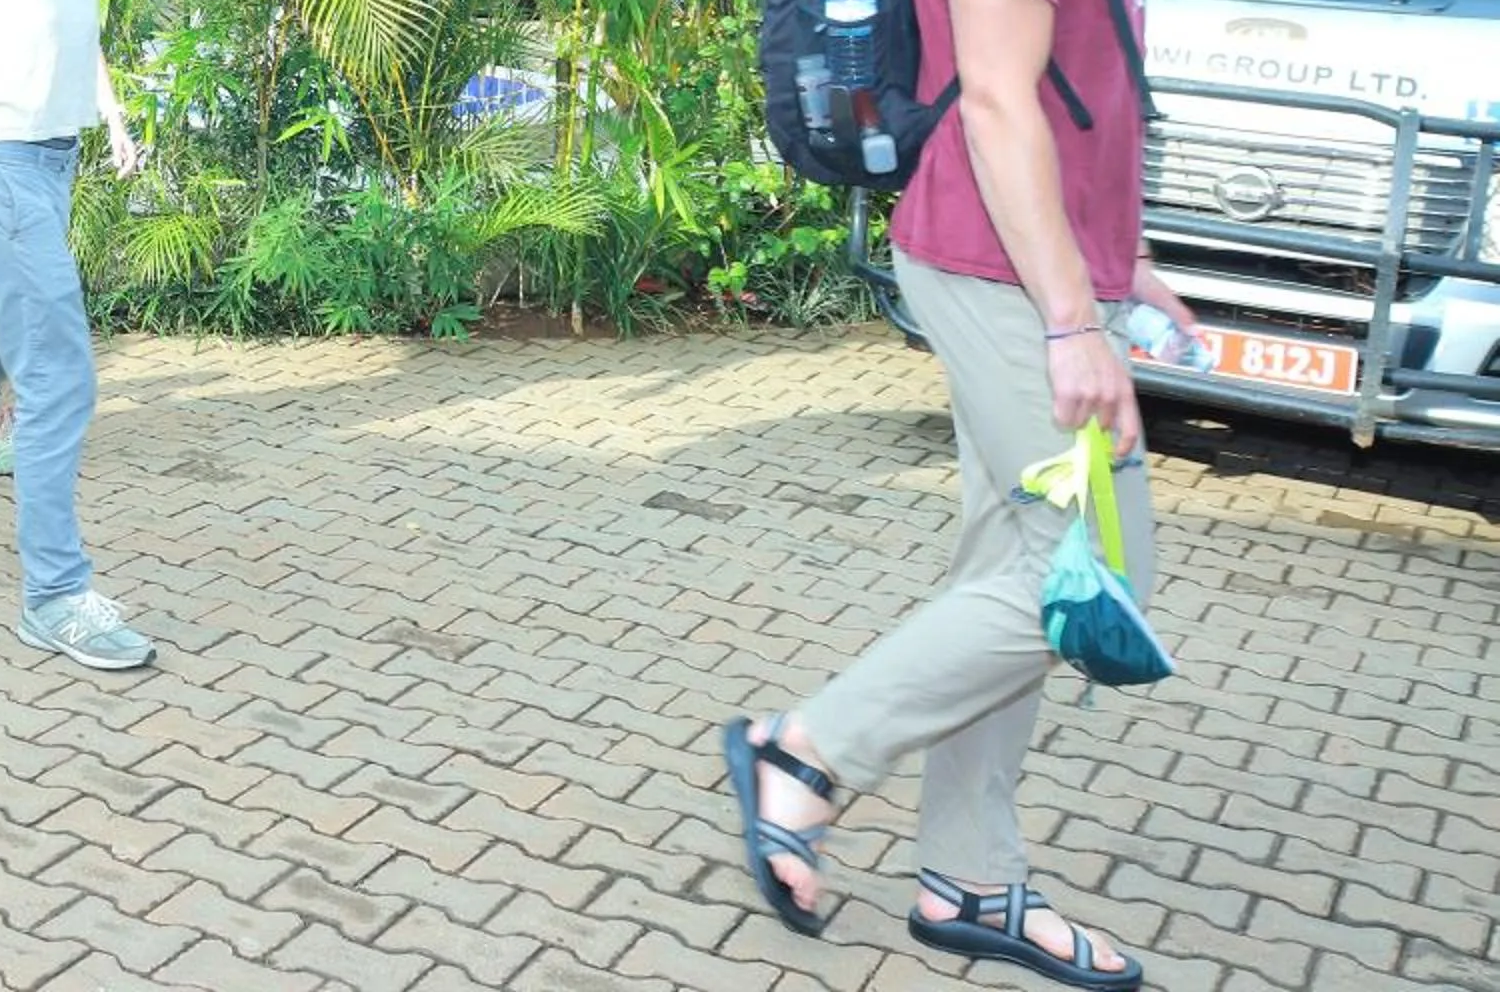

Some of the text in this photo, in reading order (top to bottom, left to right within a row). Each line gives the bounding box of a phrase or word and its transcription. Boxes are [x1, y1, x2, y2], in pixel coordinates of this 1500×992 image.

[1147, 45, 1428, 100] WI GROUP LTD.
[1240, 338, 1336, 386] 812J
